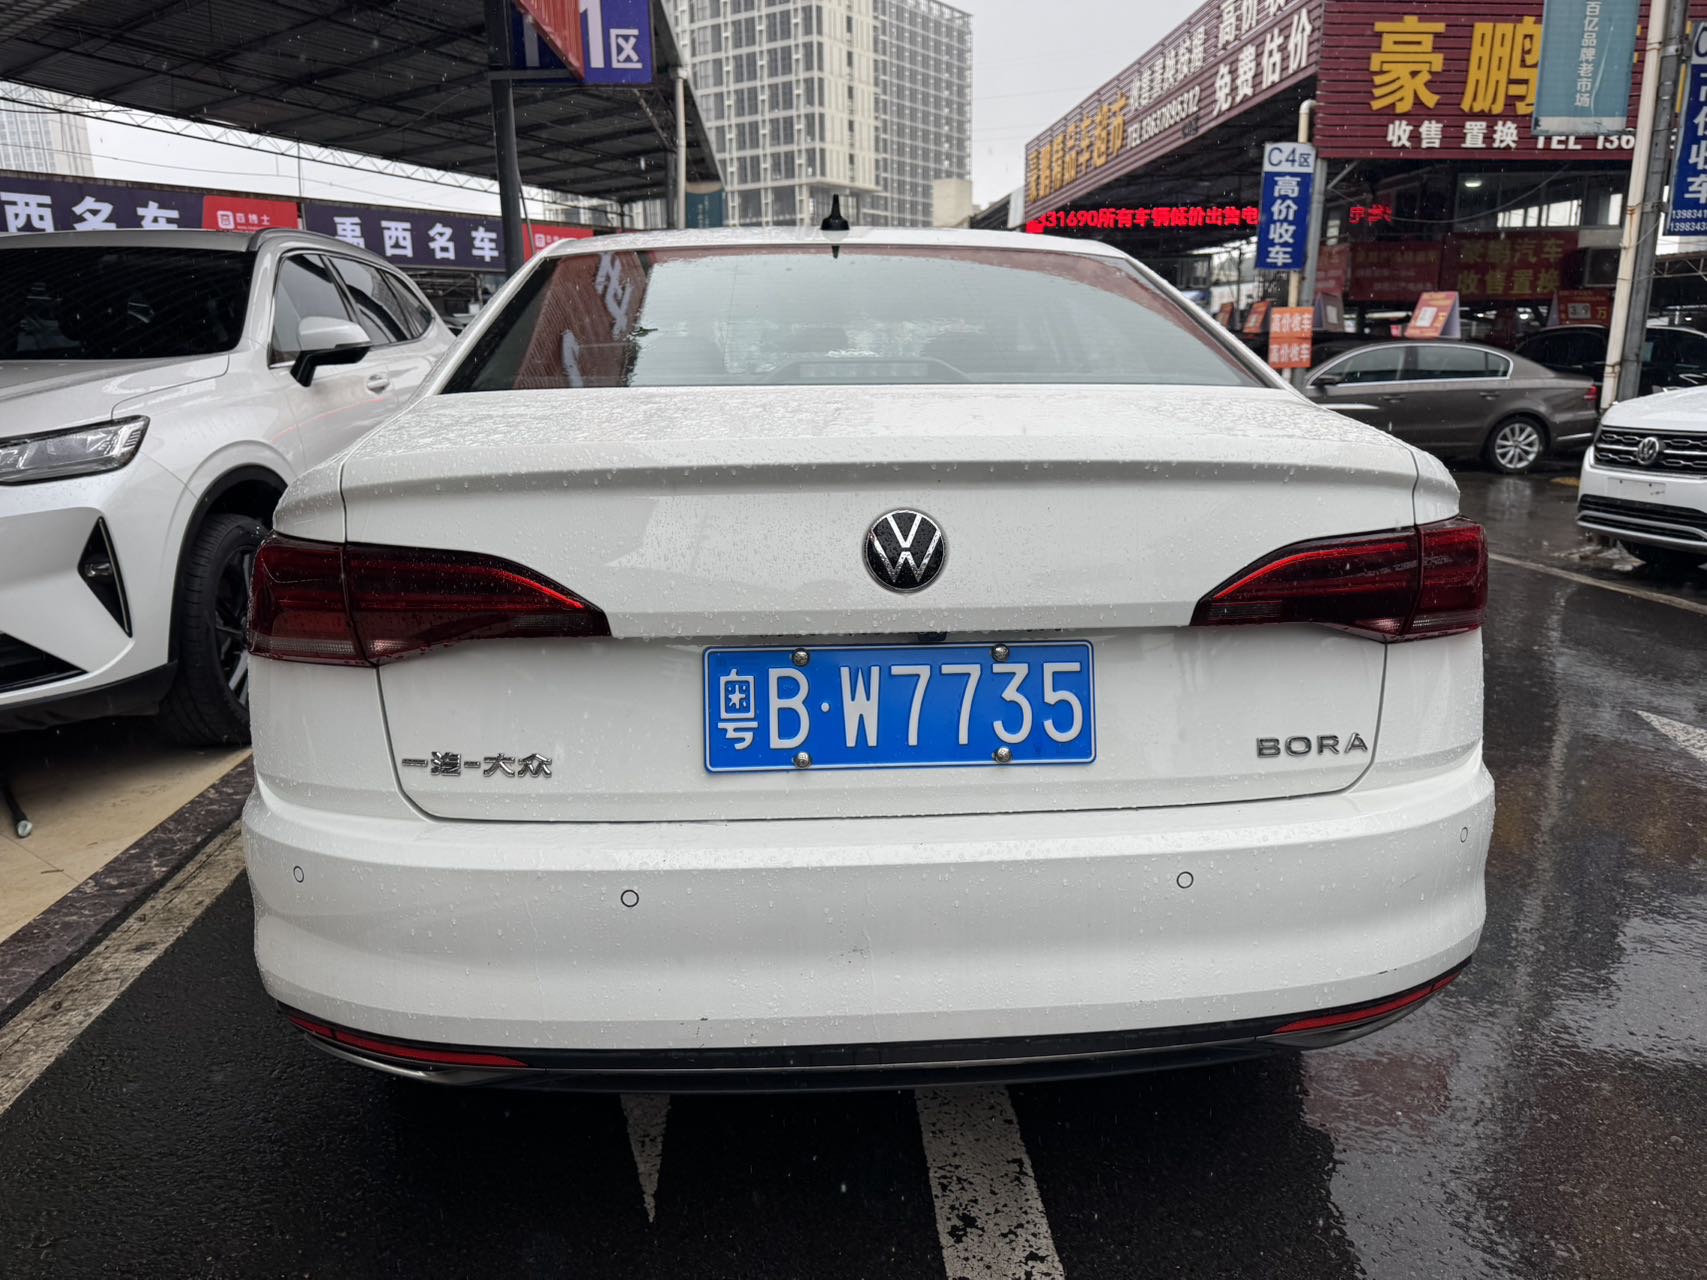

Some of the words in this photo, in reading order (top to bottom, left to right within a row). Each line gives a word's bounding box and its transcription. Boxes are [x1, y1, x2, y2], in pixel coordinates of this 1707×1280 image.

[1213, 8, 1312, 117] 免费估价
[1386, 120, 1443, 149] 收售
[1461, 121, 1518, 149] 置换
[1268, 147, 1311, 168] C4区
[1266, 175, 1301, 266] 高价收车
[1256, 732, 1368, 758] BORA
